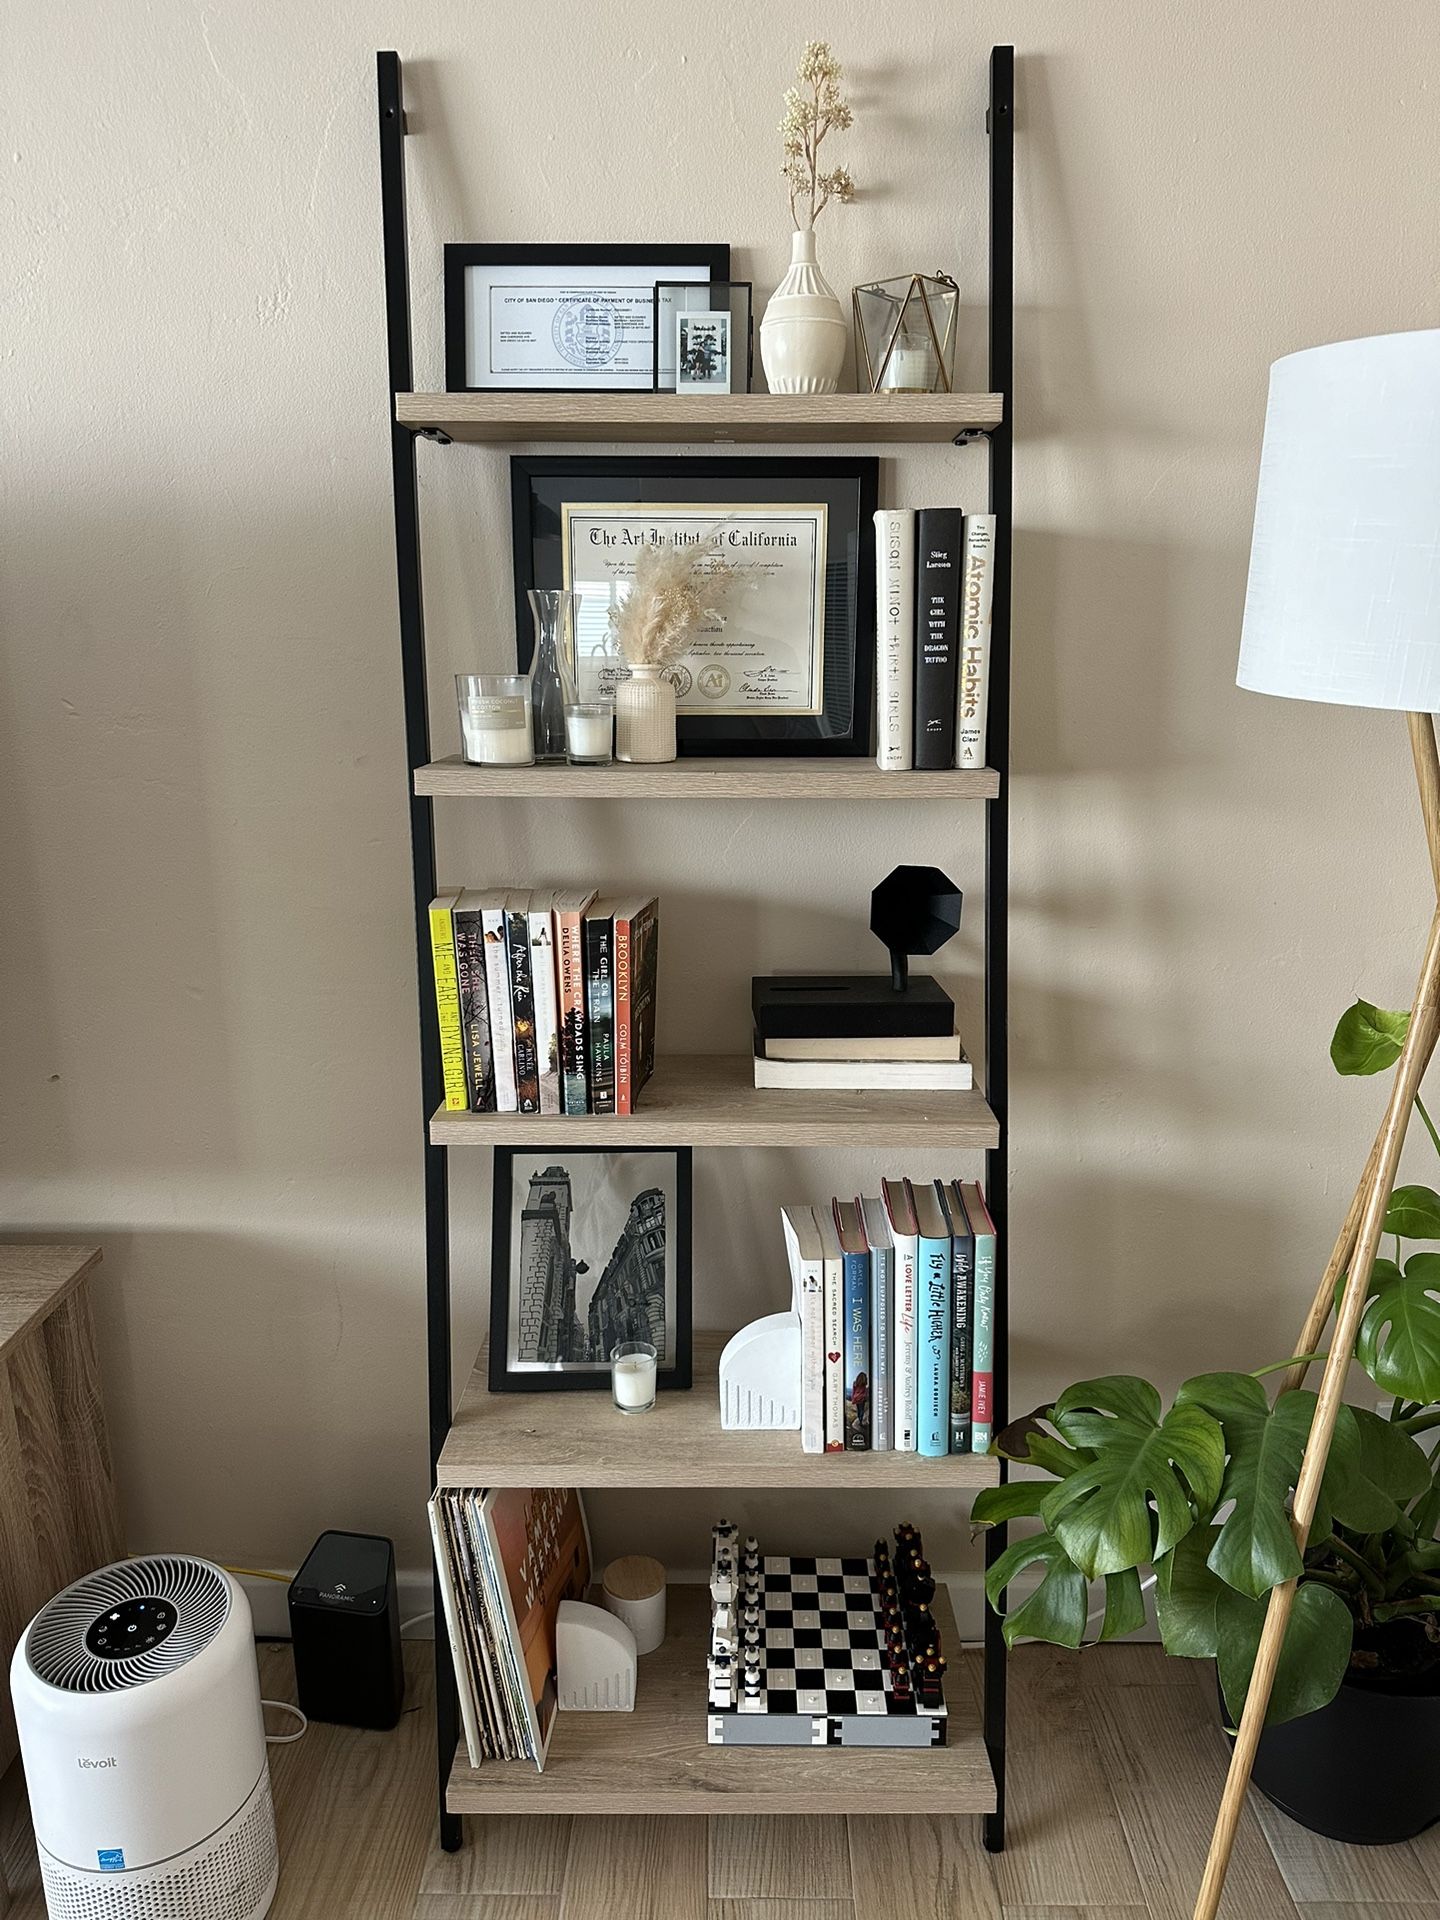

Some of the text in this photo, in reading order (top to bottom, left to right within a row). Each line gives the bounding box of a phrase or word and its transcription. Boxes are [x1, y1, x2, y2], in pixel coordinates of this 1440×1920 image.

[589, 528, 617, 548] The
[621, 528, 645, 546] Art
[728, 528, 798, 548] California
[930, 550, 948, 560] Stieg
[929, 608, 946, 616] GIRL
[930, 596, 945, 604] THE
[928, 620, 946, 628] WITH
[929, 632, 944, 640] THE
[964, 555, 988, 718] Atomic Habits
[923, 644, 949, 652] DRAGON
[924, 656, 948, 664] TATTOO
[434, 942, 454, 961] ME
[456, 932, 470, 994] WAS GONE
[562, 927, 571, 993] DELIA OWENS
[511, 943, 530, 1002] After the Rain
[600, 934, 609, 997] THE GIRL ON
[618, 935, 628, 1001] BROOKLYN
[437, 977, 459, 1010] EARL
[471, 970, 481, 991] SHE
[571, 924, 585, 1080] WHERE THE CRAWDADS SING
[592, 968, 601, 1023] THE TRAIN
[440, 1025, 463, 1064] DYING
[619, 1023, 628, 1049] COLM
[470, 1023, 484, 1091] LISA JEWELL
[517, 1044, 526, 1076] CARLINO
[526, 1047, 535, 1071] RENÉE
[444, 1069, 465, 1094] GIRL
[905, 1263, 913, 1284] LOVE
[904, 1285, 912, 1312] LETTER
[956, 1274, 967, 1329] AWAKENING
[852, 1307, 863, 1333] WAS
[880, 1322, 886, 1331] TO
[900, 1312, 915, 1334] Life
[852, 1336, 863, 1367] HERE
[977, 1380, 987, 1415] JAMIE IVEY
[318, 1591, 356, 1602] PANORAMIC
